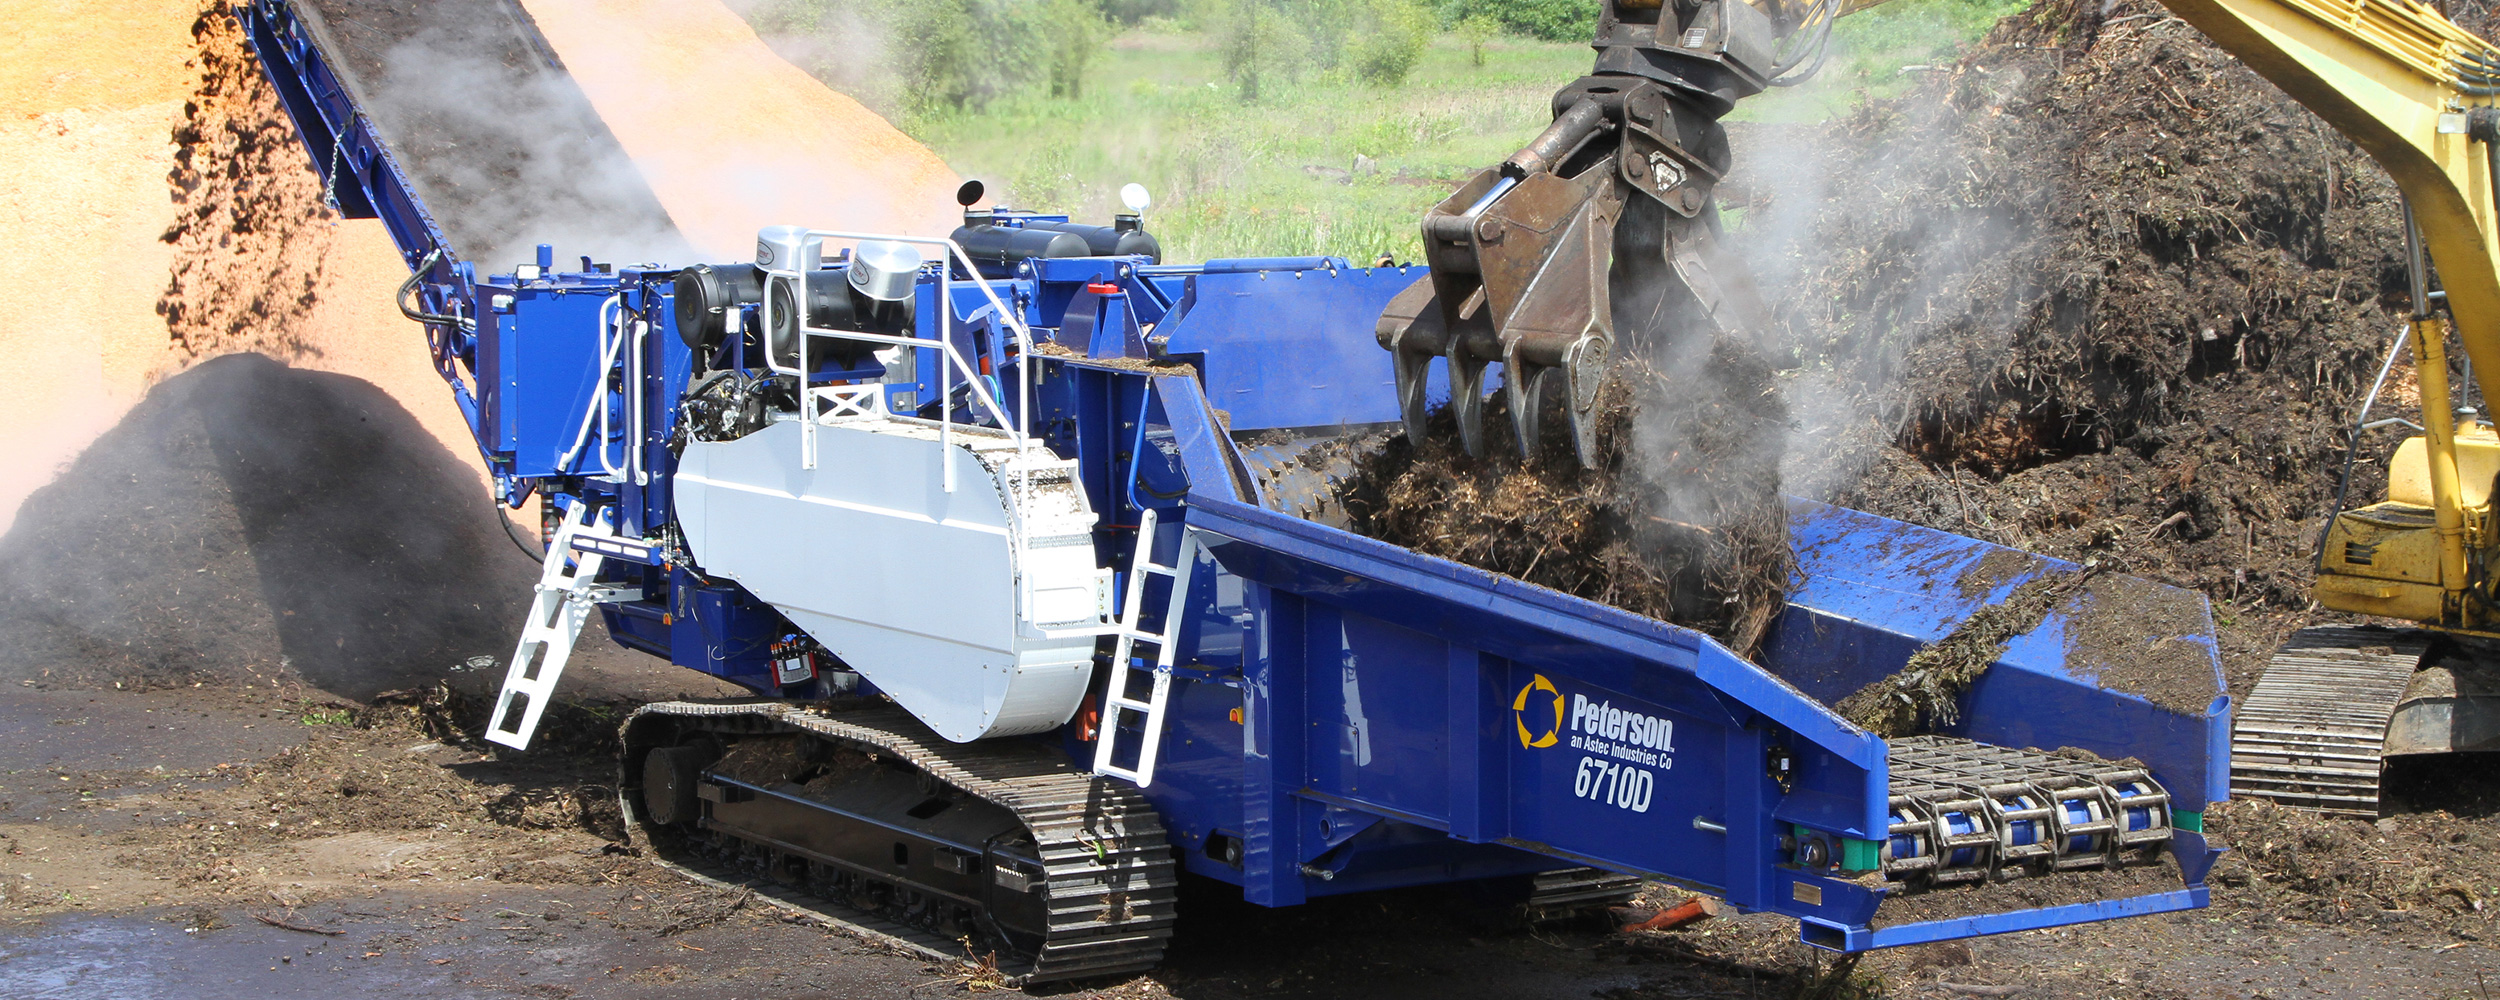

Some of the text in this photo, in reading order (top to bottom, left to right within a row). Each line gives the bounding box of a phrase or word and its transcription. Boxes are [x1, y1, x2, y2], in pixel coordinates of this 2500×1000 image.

[1571, 694, 1673, 752] Peterson
[1570, 735, 1672, 770] an Astec Industries Co
[1575, 756, 1653, 813] 6710D
